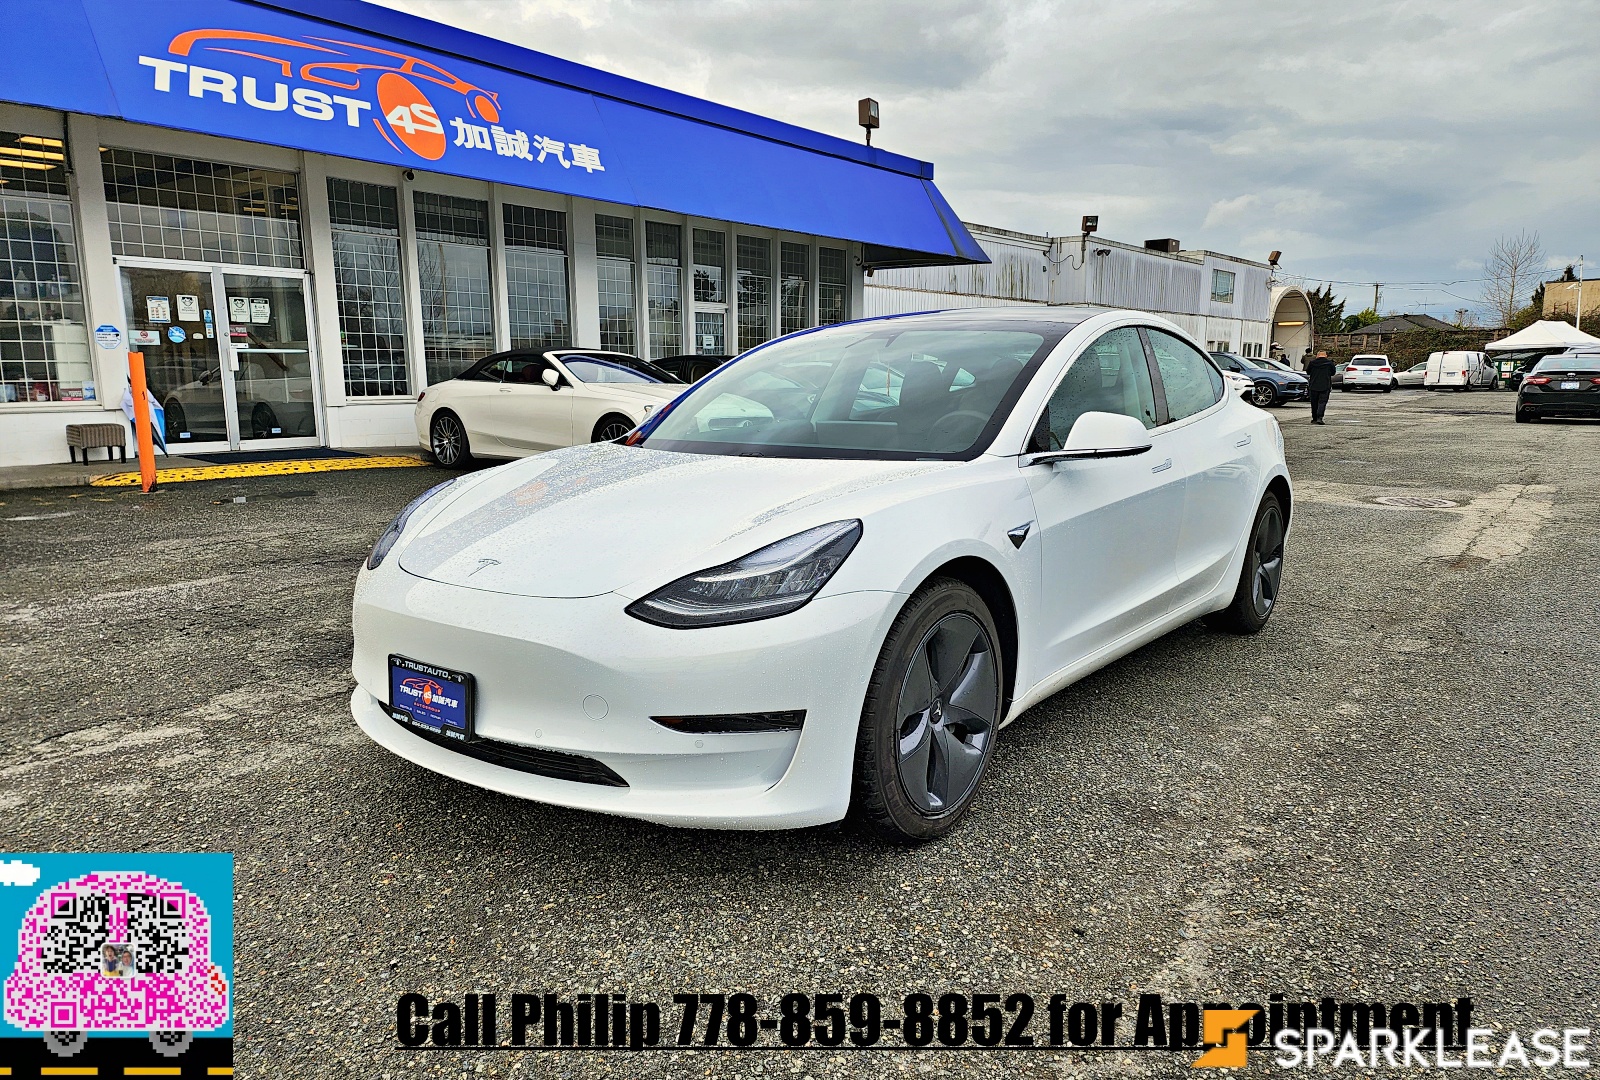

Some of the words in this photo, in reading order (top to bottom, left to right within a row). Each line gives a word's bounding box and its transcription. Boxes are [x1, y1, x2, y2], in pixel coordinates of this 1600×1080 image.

[139, 56, 371, 128] TRUST
[385, 104, 444, 135] 4S
[449, 116, 605, 174] 加誠汽車
[404, 661, 449, 678] TRUSTAUTO
[400, 685, 422, 698] TRUST
